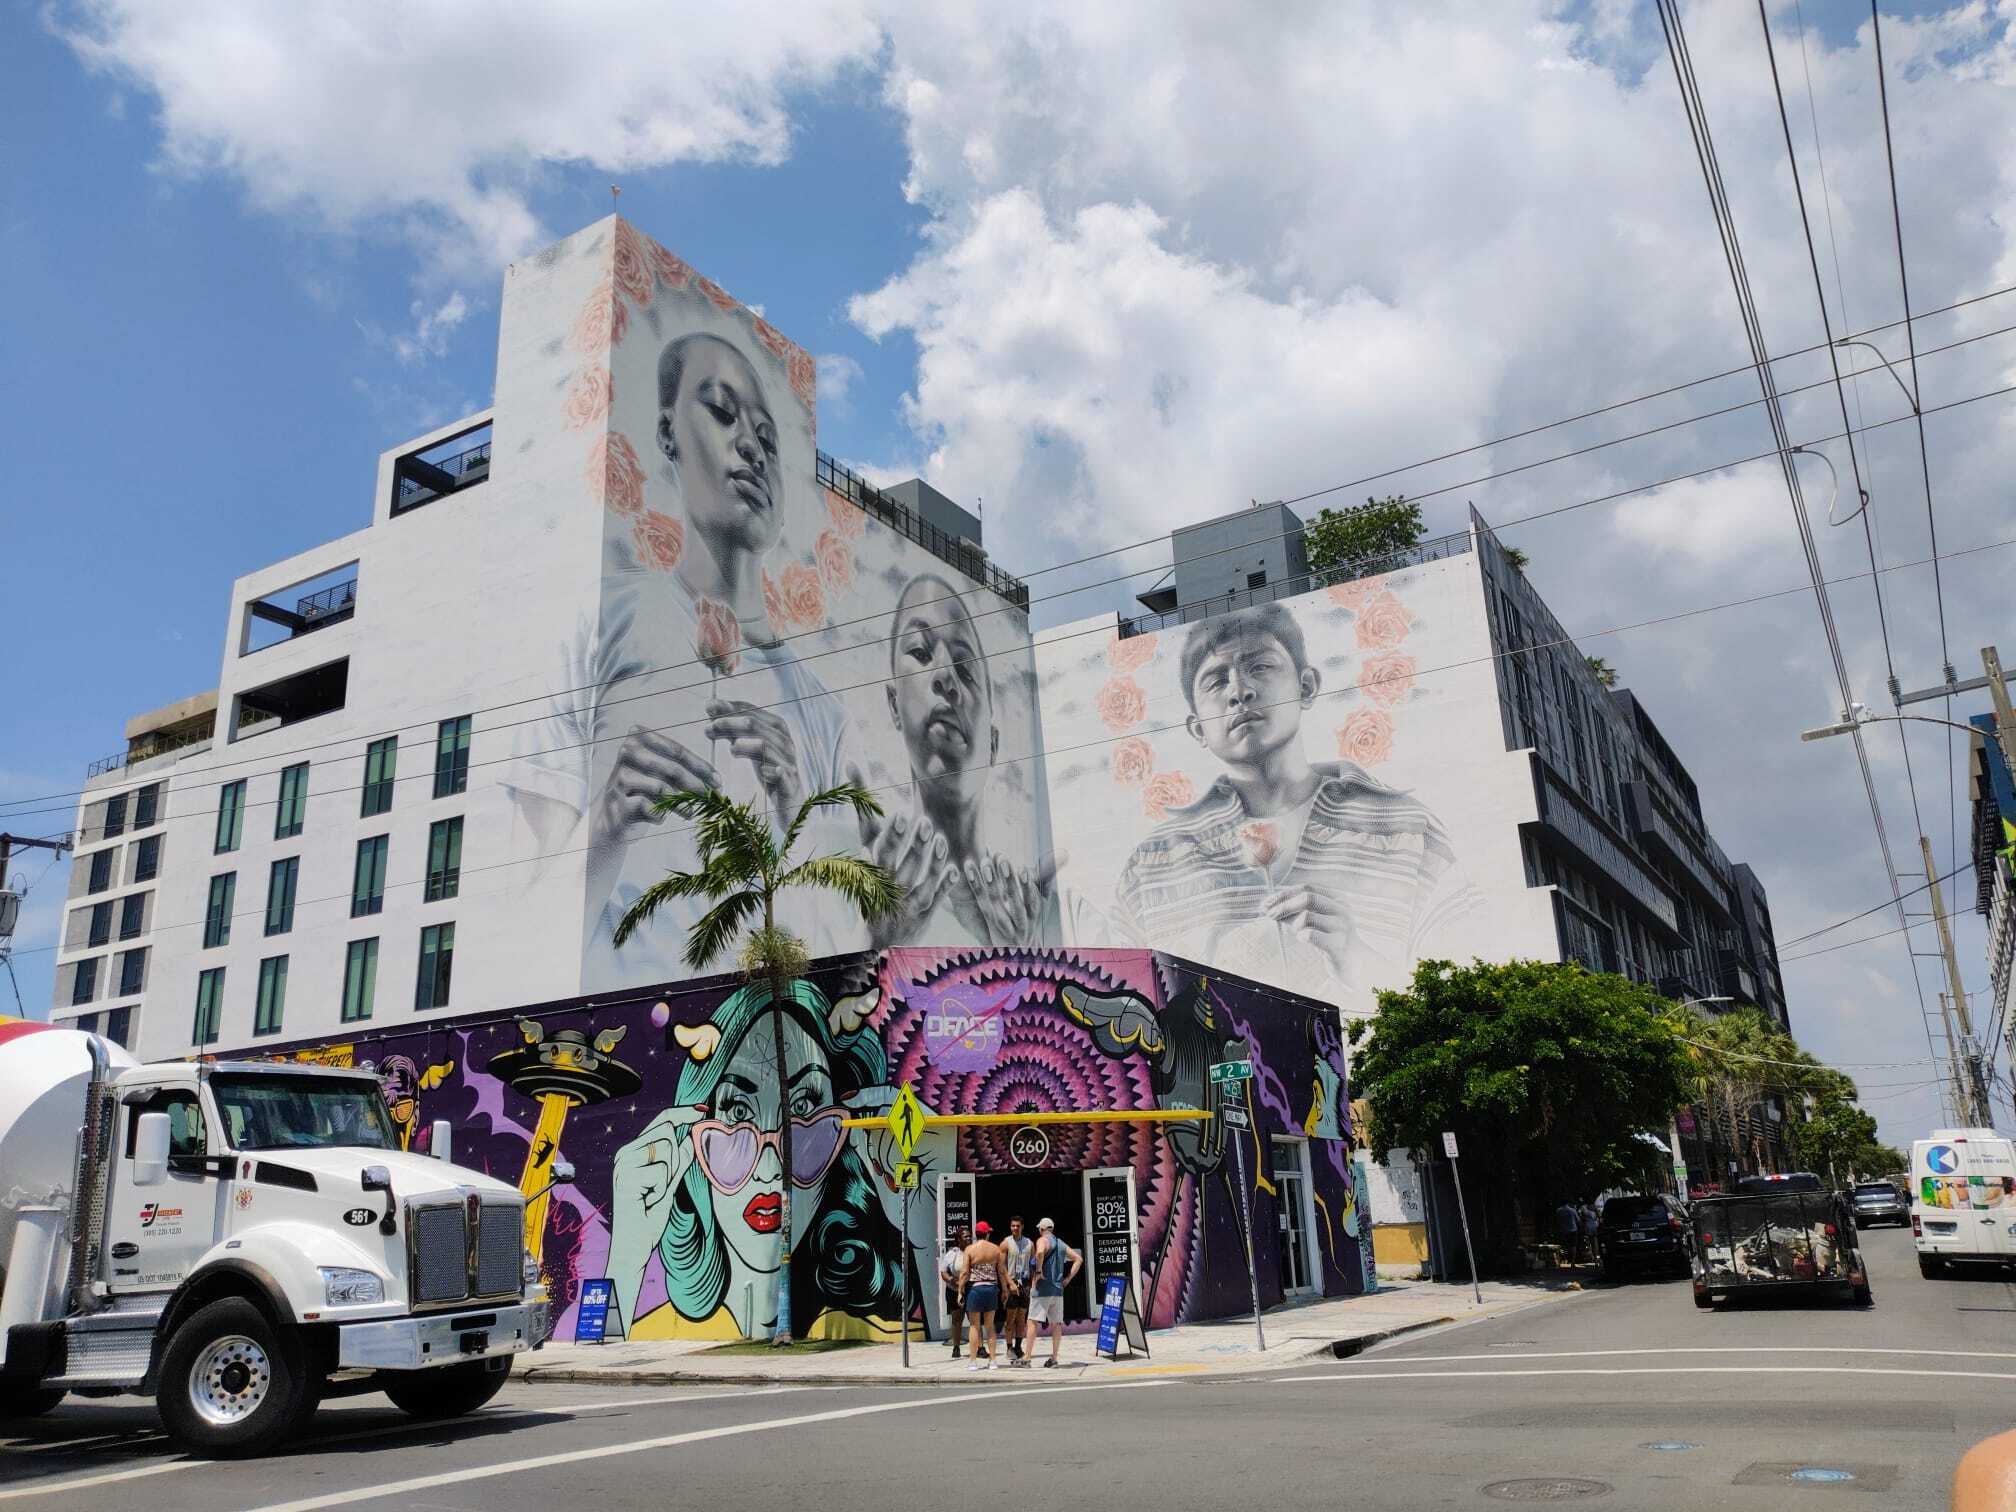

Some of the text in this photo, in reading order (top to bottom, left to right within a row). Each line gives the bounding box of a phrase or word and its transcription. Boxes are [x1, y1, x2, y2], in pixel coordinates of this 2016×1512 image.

[1226, 1065, 1235, 1078] 2
[1240, 1065, 1250, 1075] AV
[1016, 1140, 1045, 1153] 260
[1097, 1201, 1126, 1215] 80%
[351, 1210, 369, 1223] 561
[947, 1212, 969, 1221] SAMPLE
[1097, 1215, 1126, 1229] OFF
